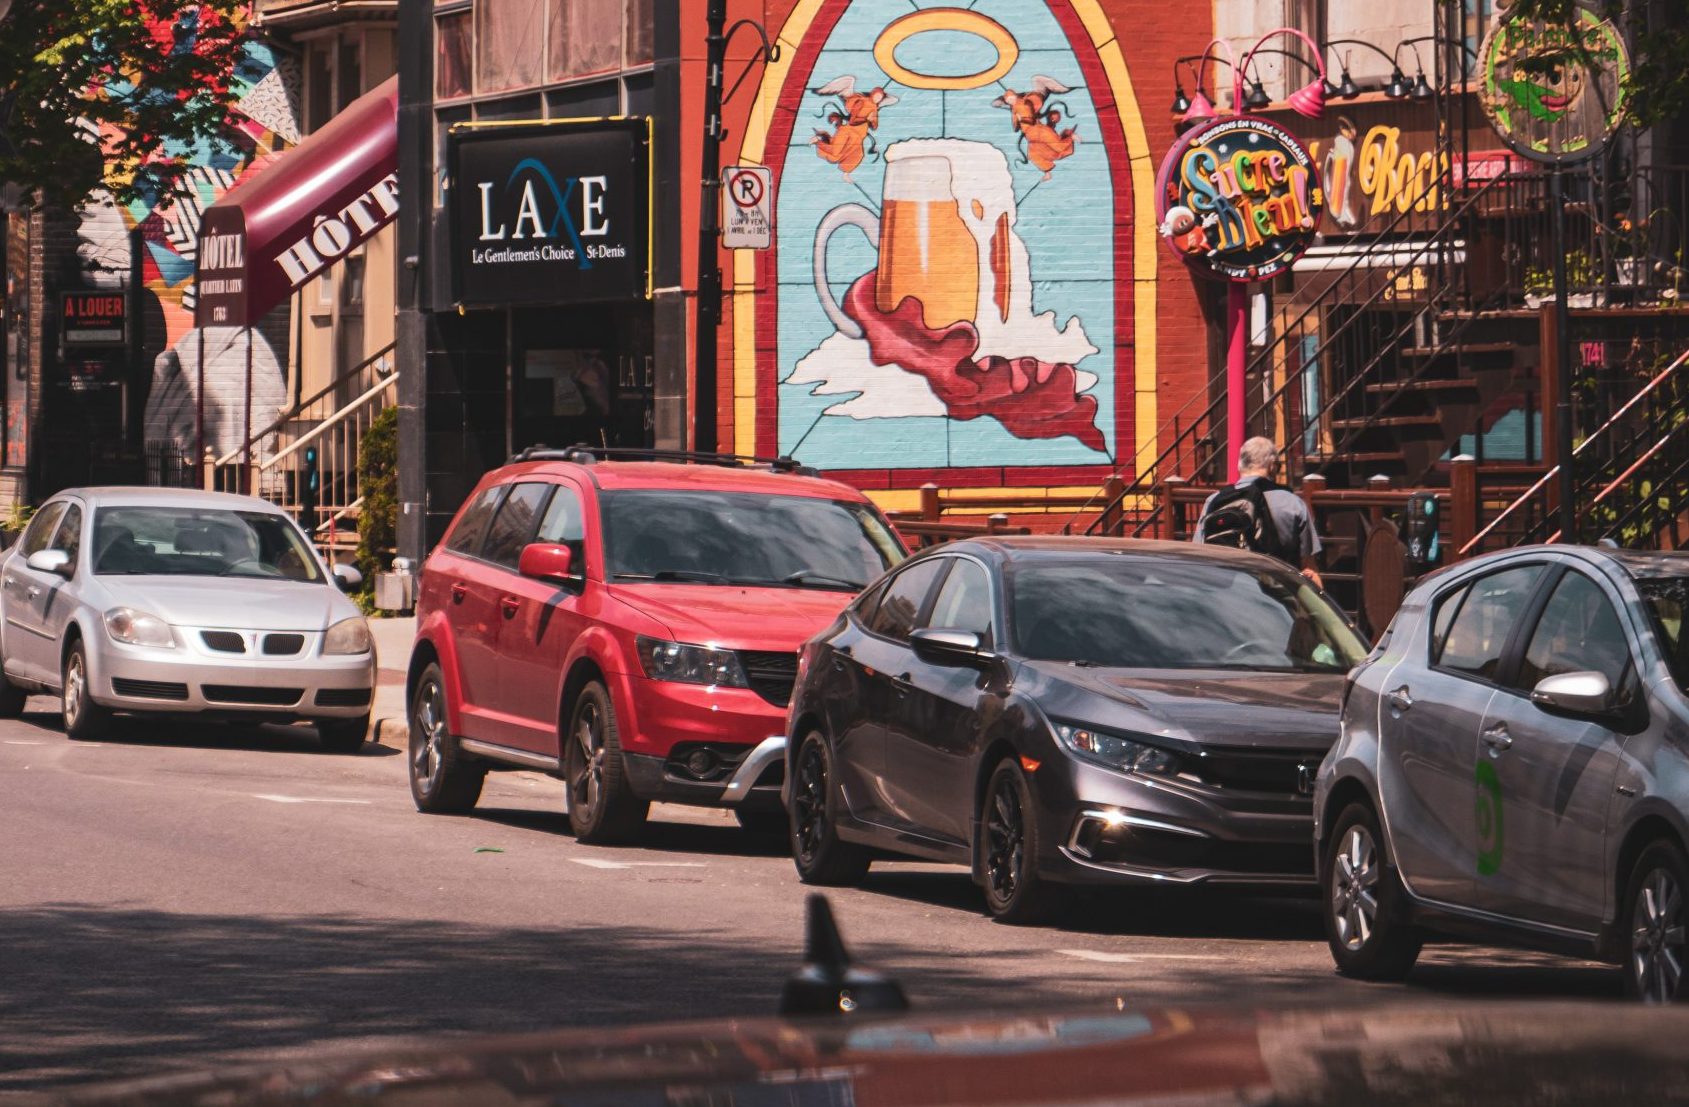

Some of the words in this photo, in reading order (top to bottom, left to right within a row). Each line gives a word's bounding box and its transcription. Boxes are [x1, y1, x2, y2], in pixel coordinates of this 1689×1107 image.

[1237, 120, 1250, 128] EN
[1185, 151, 1284, 209] Sucre
[478, 164, 609, 264] LAXE
[273, 170, 399, 287] HÔTE
[200, 226, 243, 270] HÔTEL
[472, 249, 484, 264] Le
[484, 247, 540, 263] Gentlemen's
[541, 245, 575, 261] Choice
[586, 243, 625, 259] St-Denis
[1258, 263, 1277, 276] PEZ
[226, 279, 242, 294] LATIN
[79, 297, 123, 316] LOUER
